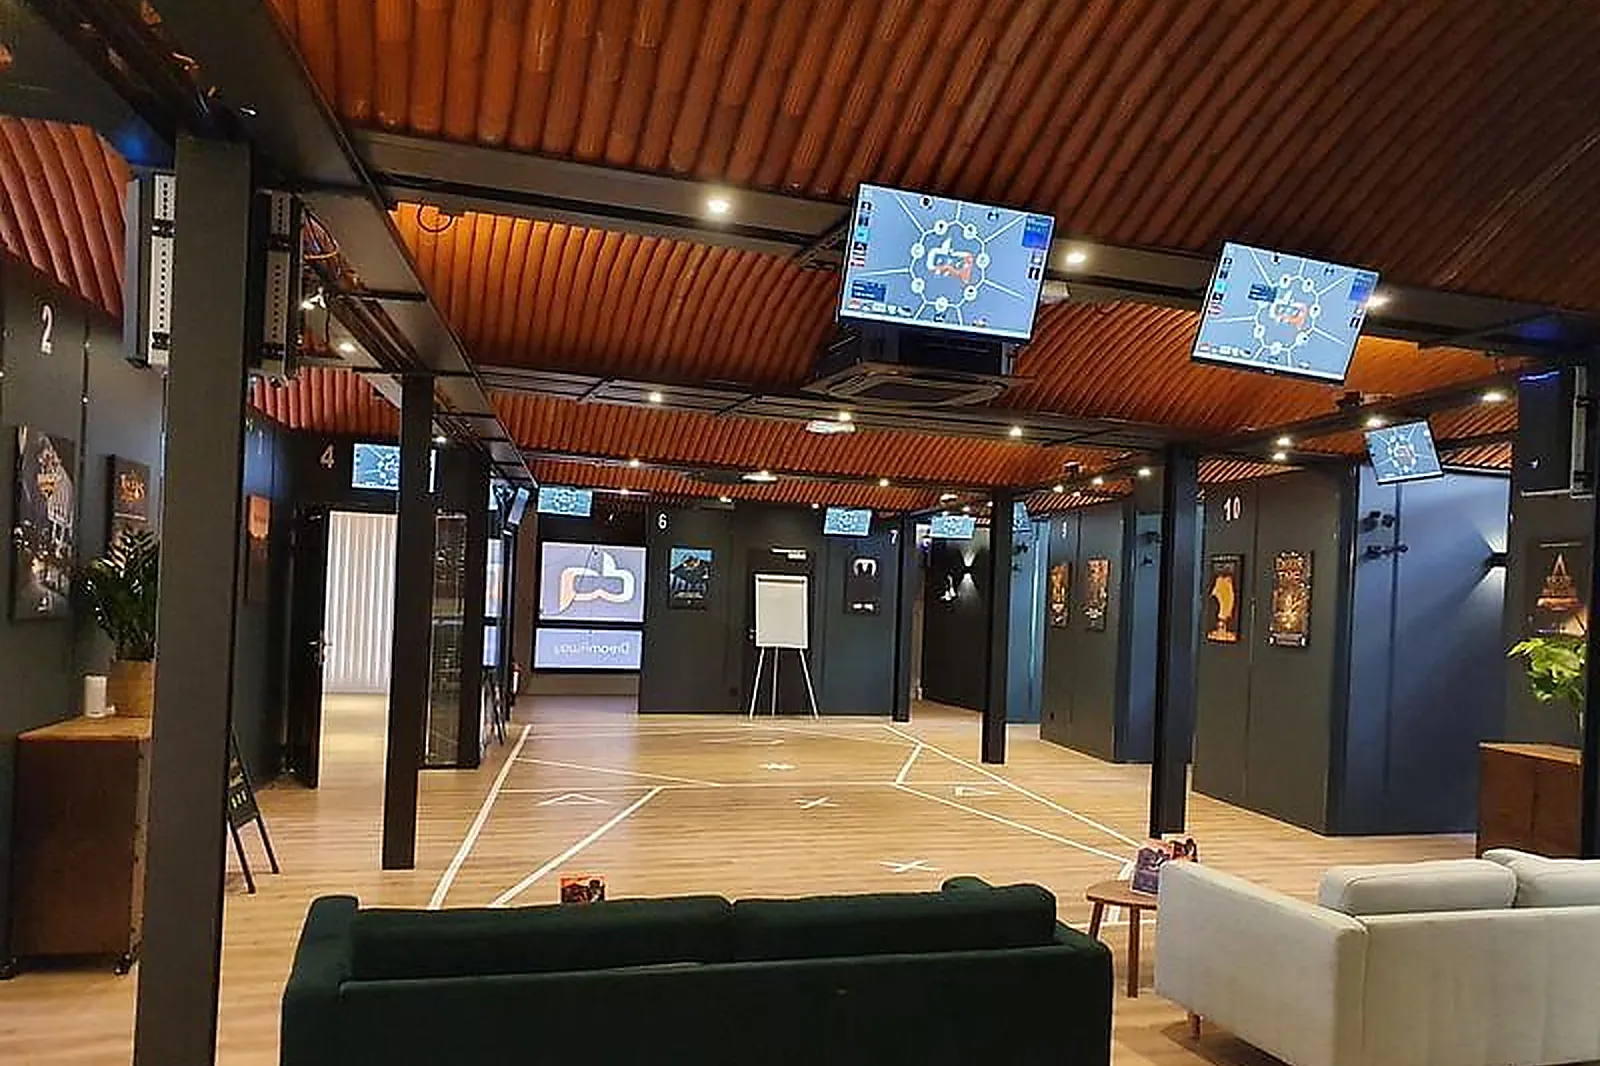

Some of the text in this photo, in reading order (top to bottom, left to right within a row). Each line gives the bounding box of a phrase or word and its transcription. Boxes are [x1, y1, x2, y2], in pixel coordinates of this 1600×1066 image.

[42, 304, 53, 354] 2
[319, 443, 335, 469] 4
[657, 512, 668, 530] 6
[1223, 496, 1241, 521] 10
[888, 528, 899, 545] 7
